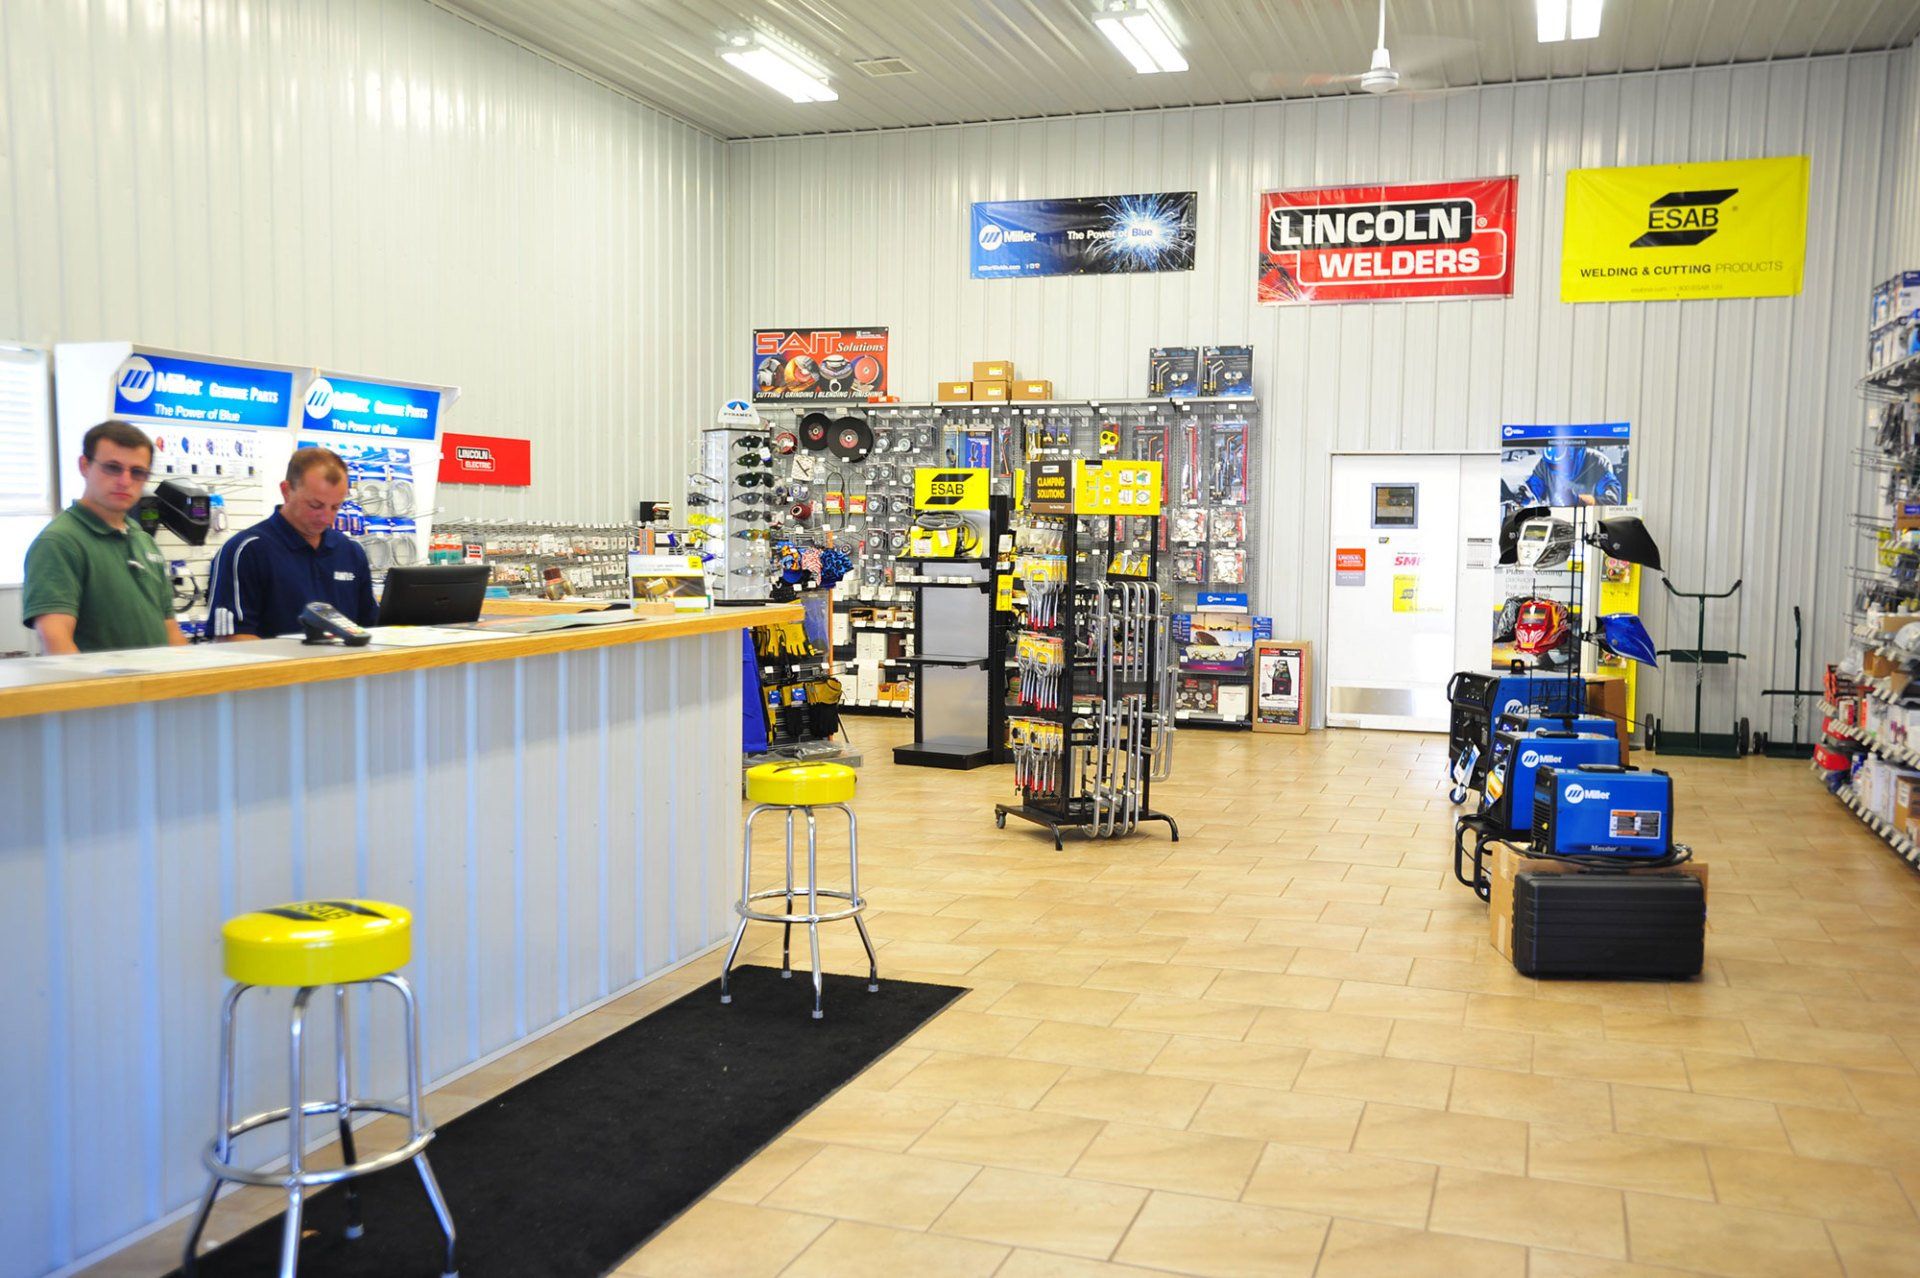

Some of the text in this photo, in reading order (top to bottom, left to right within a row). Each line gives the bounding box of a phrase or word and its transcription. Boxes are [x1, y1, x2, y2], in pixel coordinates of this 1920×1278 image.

[1648, 207, 1719, 229] ESAB
[1280, 207, 1461, 246] LINCOLN
[1003, 230, 1036, 243] Miller
[1067, 228, 1153, 240] The Power of Blue
[1319, 247, 1480, 279] WELDERS
[1580, 261, 1783, 278] WELDING & CUTTING PRODUCTS
[756, 331, 842, 354] SAIT
[836, 342, 884, 352] Solutions
[156, 371, 203, 396] Miller
[154, 403, 240, 422] The Power of Blue
[331, 418, 398, 435] The Power of Blue
[457, 448, 488, 459] LINCOLN
[465, 461, 492, 469] ELECTRIC
[1037, 477, 1065, 487] CLAMPING
[931, 484, 964, 495] ESAB
[1037, 489, 1065, 499] SOLUTIONS
[1539, 754, 1563, 764] Miller
[1585, 789, 1611, 800] Miller
